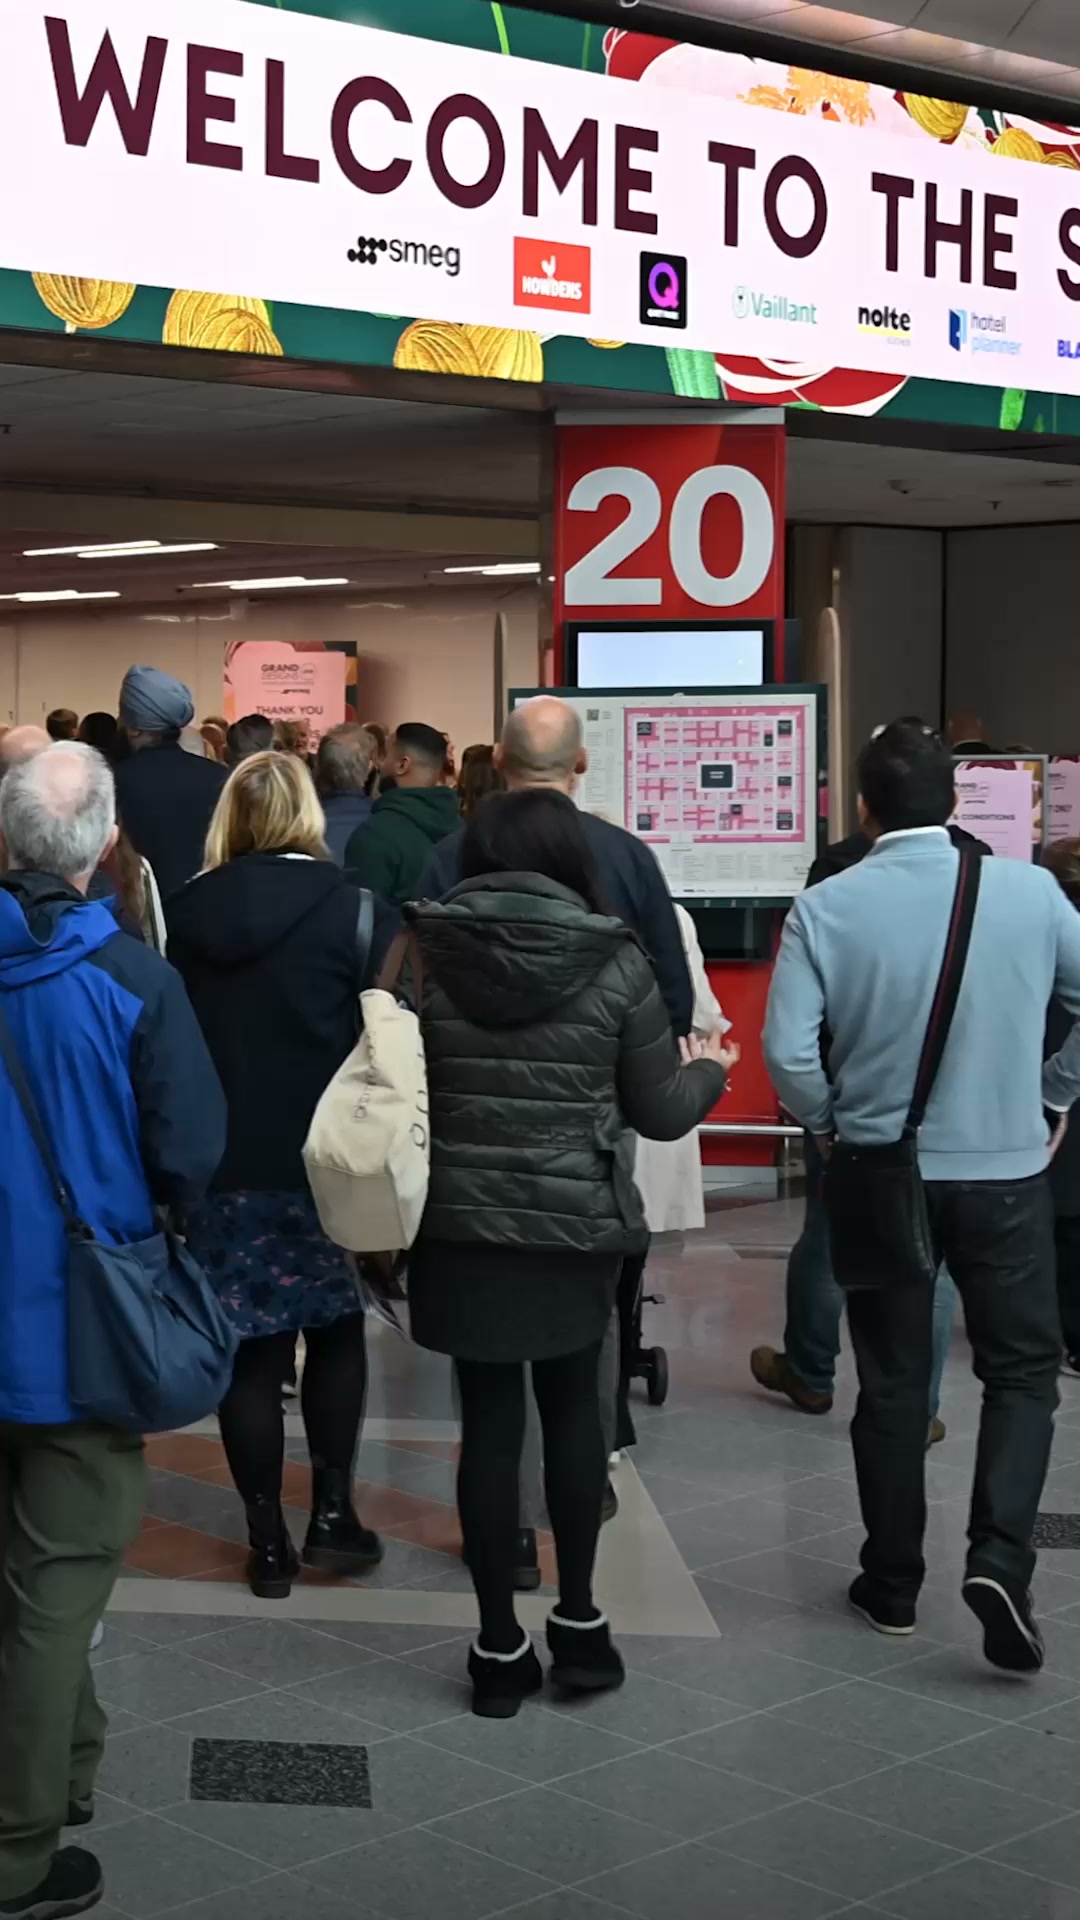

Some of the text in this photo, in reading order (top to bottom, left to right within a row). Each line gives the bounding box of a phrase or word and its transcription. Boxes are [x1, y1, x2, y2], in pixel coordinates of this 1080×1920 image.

[43, 16, 659, 236] WELCOME
[708, 141, 828, 259] TO
[872, 172, 1018, 291] THE
[389, 239, 461, 277] smeg
[522, 275, 583, 300] HOWDENS
[648, 261, 679, 309] Q
[751, 292, 818, 325] Vaillant
[858, 306, 911, 332] nolte
[970, 312, 1007, 333] hotel
[564, 465, 775, 607] 20
[261, 664, 299, 672] GRAND
[256, 706, 323, 715] THANK YOU
